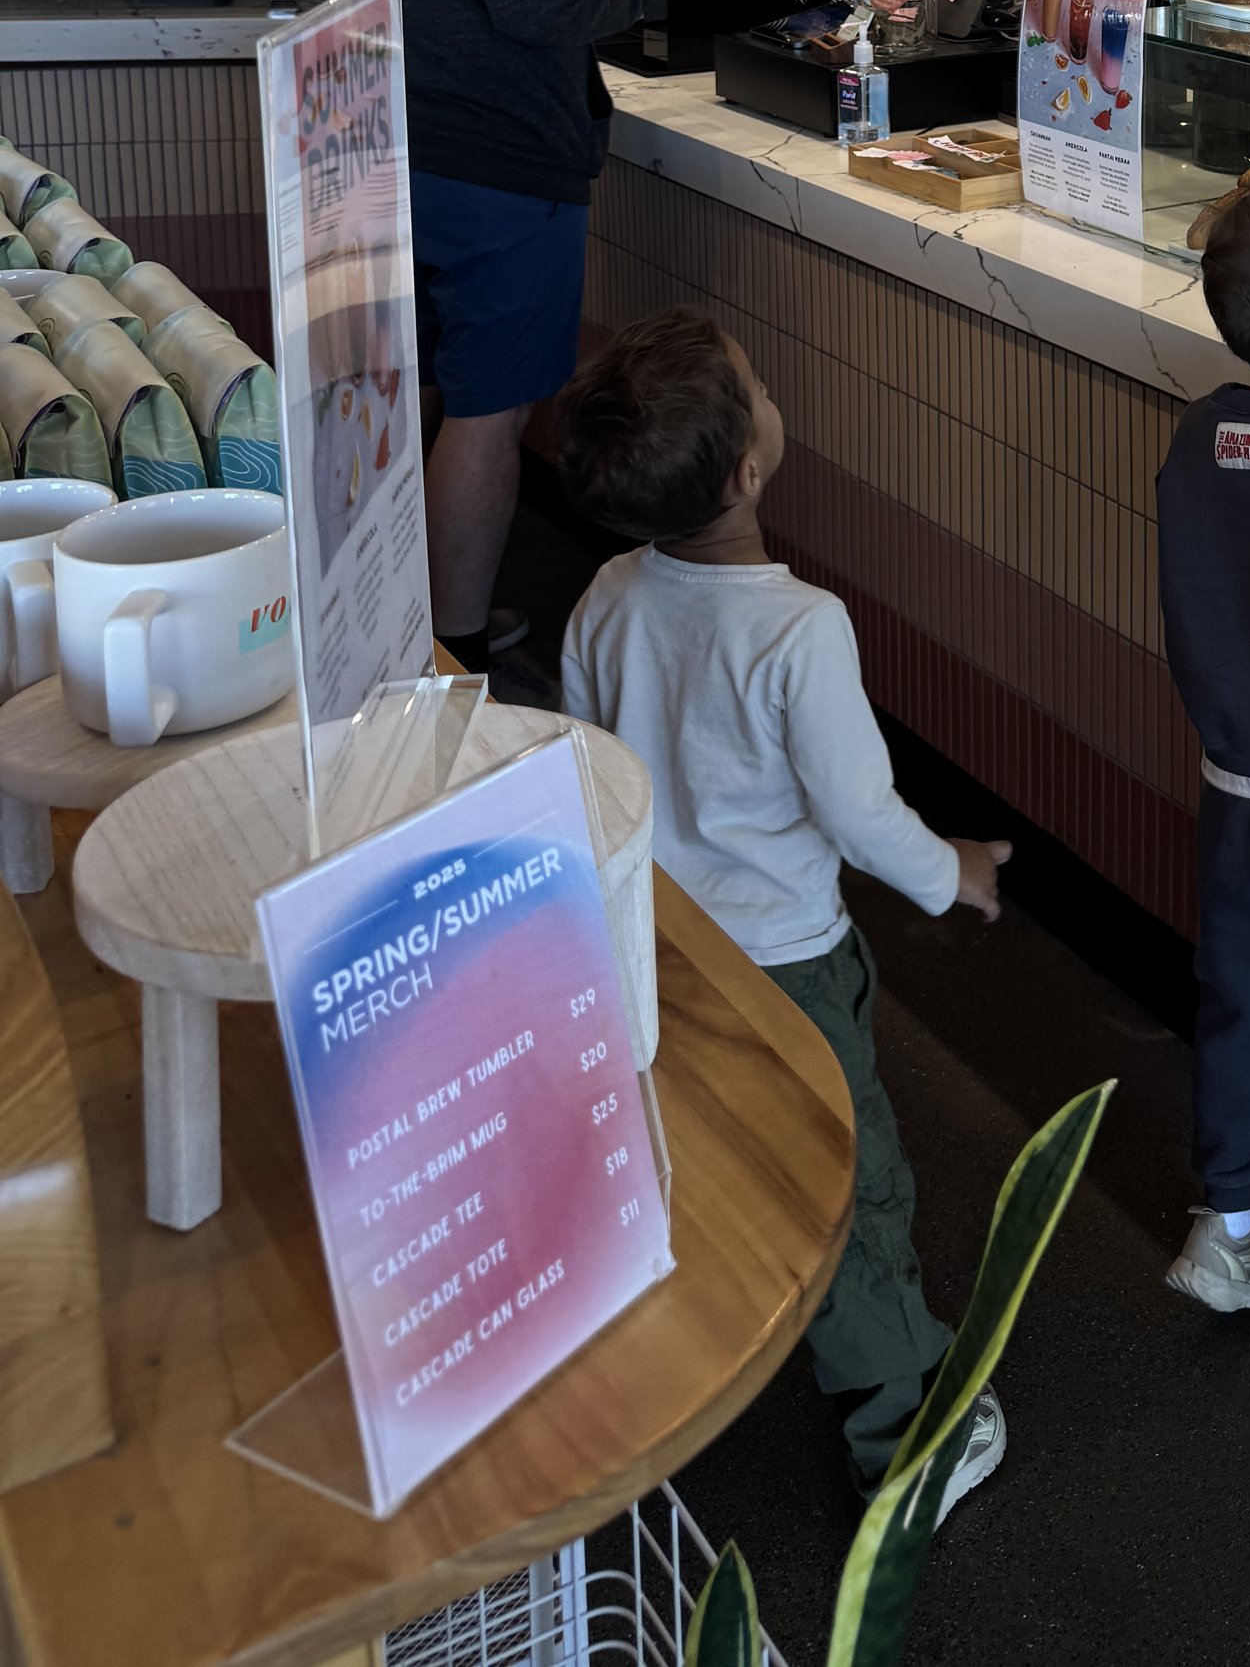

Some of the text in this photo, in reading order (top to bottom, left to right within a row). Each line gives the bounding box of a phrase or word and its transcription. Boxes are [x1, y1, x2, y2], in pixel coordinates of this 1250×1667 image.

[302, 21, 387, 134] SUMMER
[307, 94, 390, 226] DRINKS
[312, 846, 564, 1015] SPRING/SUMMER
[412, 858, 468, 900] 2025
[319, 962, 434, 1055] MERCH
[347, 988, 597, 1171] POSTAL BREW TUMBLER $29
[359, 1041, 608, 1228] TO-THE-BRIM MUG $20
[372, 1092, 619, 1289] CASCADE TEE $25
[385, 1146, 629, 1348] CASCADE TOTE $18
[396, 1197, 641, 1408] CASCADE CAN GLASS $11
